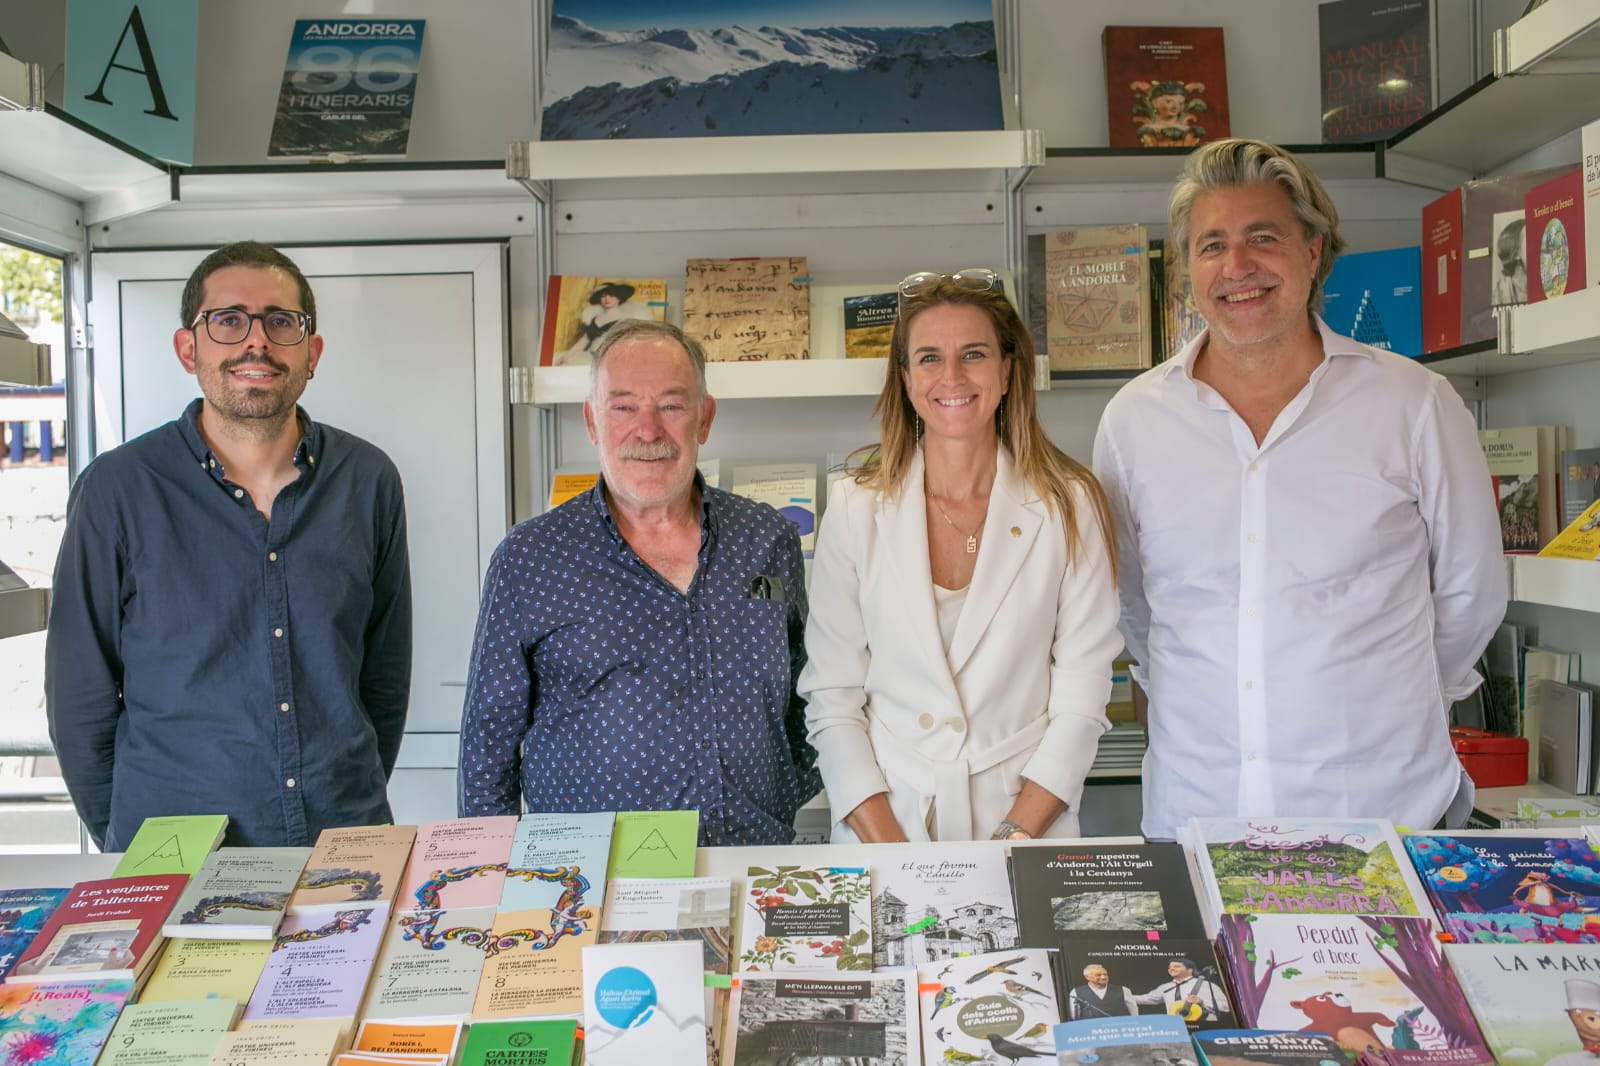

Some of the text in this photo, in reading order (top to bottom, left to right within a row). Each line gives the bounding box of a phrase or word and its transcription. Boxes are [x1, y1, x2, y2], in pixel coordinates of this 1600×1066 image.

[304, 23, 416, 36] ANDORRA
[1327, 34, 1424, 67] MANUAL
[84, 4, 180, 122] A
[291, 44, 416, 93] 86
[1327, 54, 1425, 91] DIGEST
[289, 94, 410, 107] ITINERARIS
[1085, 261, 1127, 274] MOBLE
[1059, 275, 1128, 289] A ANDORRA
[327, 847, 338, 855] 2
[428, 843, 438, 851] 5
[527, 840, 537, 851] 6
[1096, 853, 1140, 861] rupestres
[901, 862, 915, 871] El
[915, 864, 935, 873] que
[1046, 860, 1153, 869] d'Andorra, l'Alt Urgell
[926, 870, 965, 878] Canillo
[1086, 869, 1133, 878] Cerdanya
[1253, 869, 1365, 890] VALLS
[77, 883, 170, 898] Les venjances
[70, 894, 164, 909] de Talltendre
[173, 957, 186, 967] 3
[1312, 949, 1361, 964] al bosc
[1493, 955, 1529, 971] LA
[281, 967, 292, 977] 4
[387, 977, 398, 988] 7
[494, 977, 506, 988] 8
[976, 1001, 1002, 1011] Guia
[962, 1006, 1018, 1020] dels ocells
[964, 1014, 1018, 1026] d'Andorra
[1121, 1024, 1153, 1033] rural
[123, 1036, 135, 1048] 9
[1067, 1035, 1097, 1043] Mots
[1136, 1030, 1180, 1038] perden
[1213, 1037, 1325, 1046] CERDANYA
[485, 1050, 549, 1058] CARTES
[1402, 1052, 1478, 1061] SILVESTRES
[1427, 1047, 1474, 1056] FRUITS
[483, 1057, 547, 1066] MORTES
